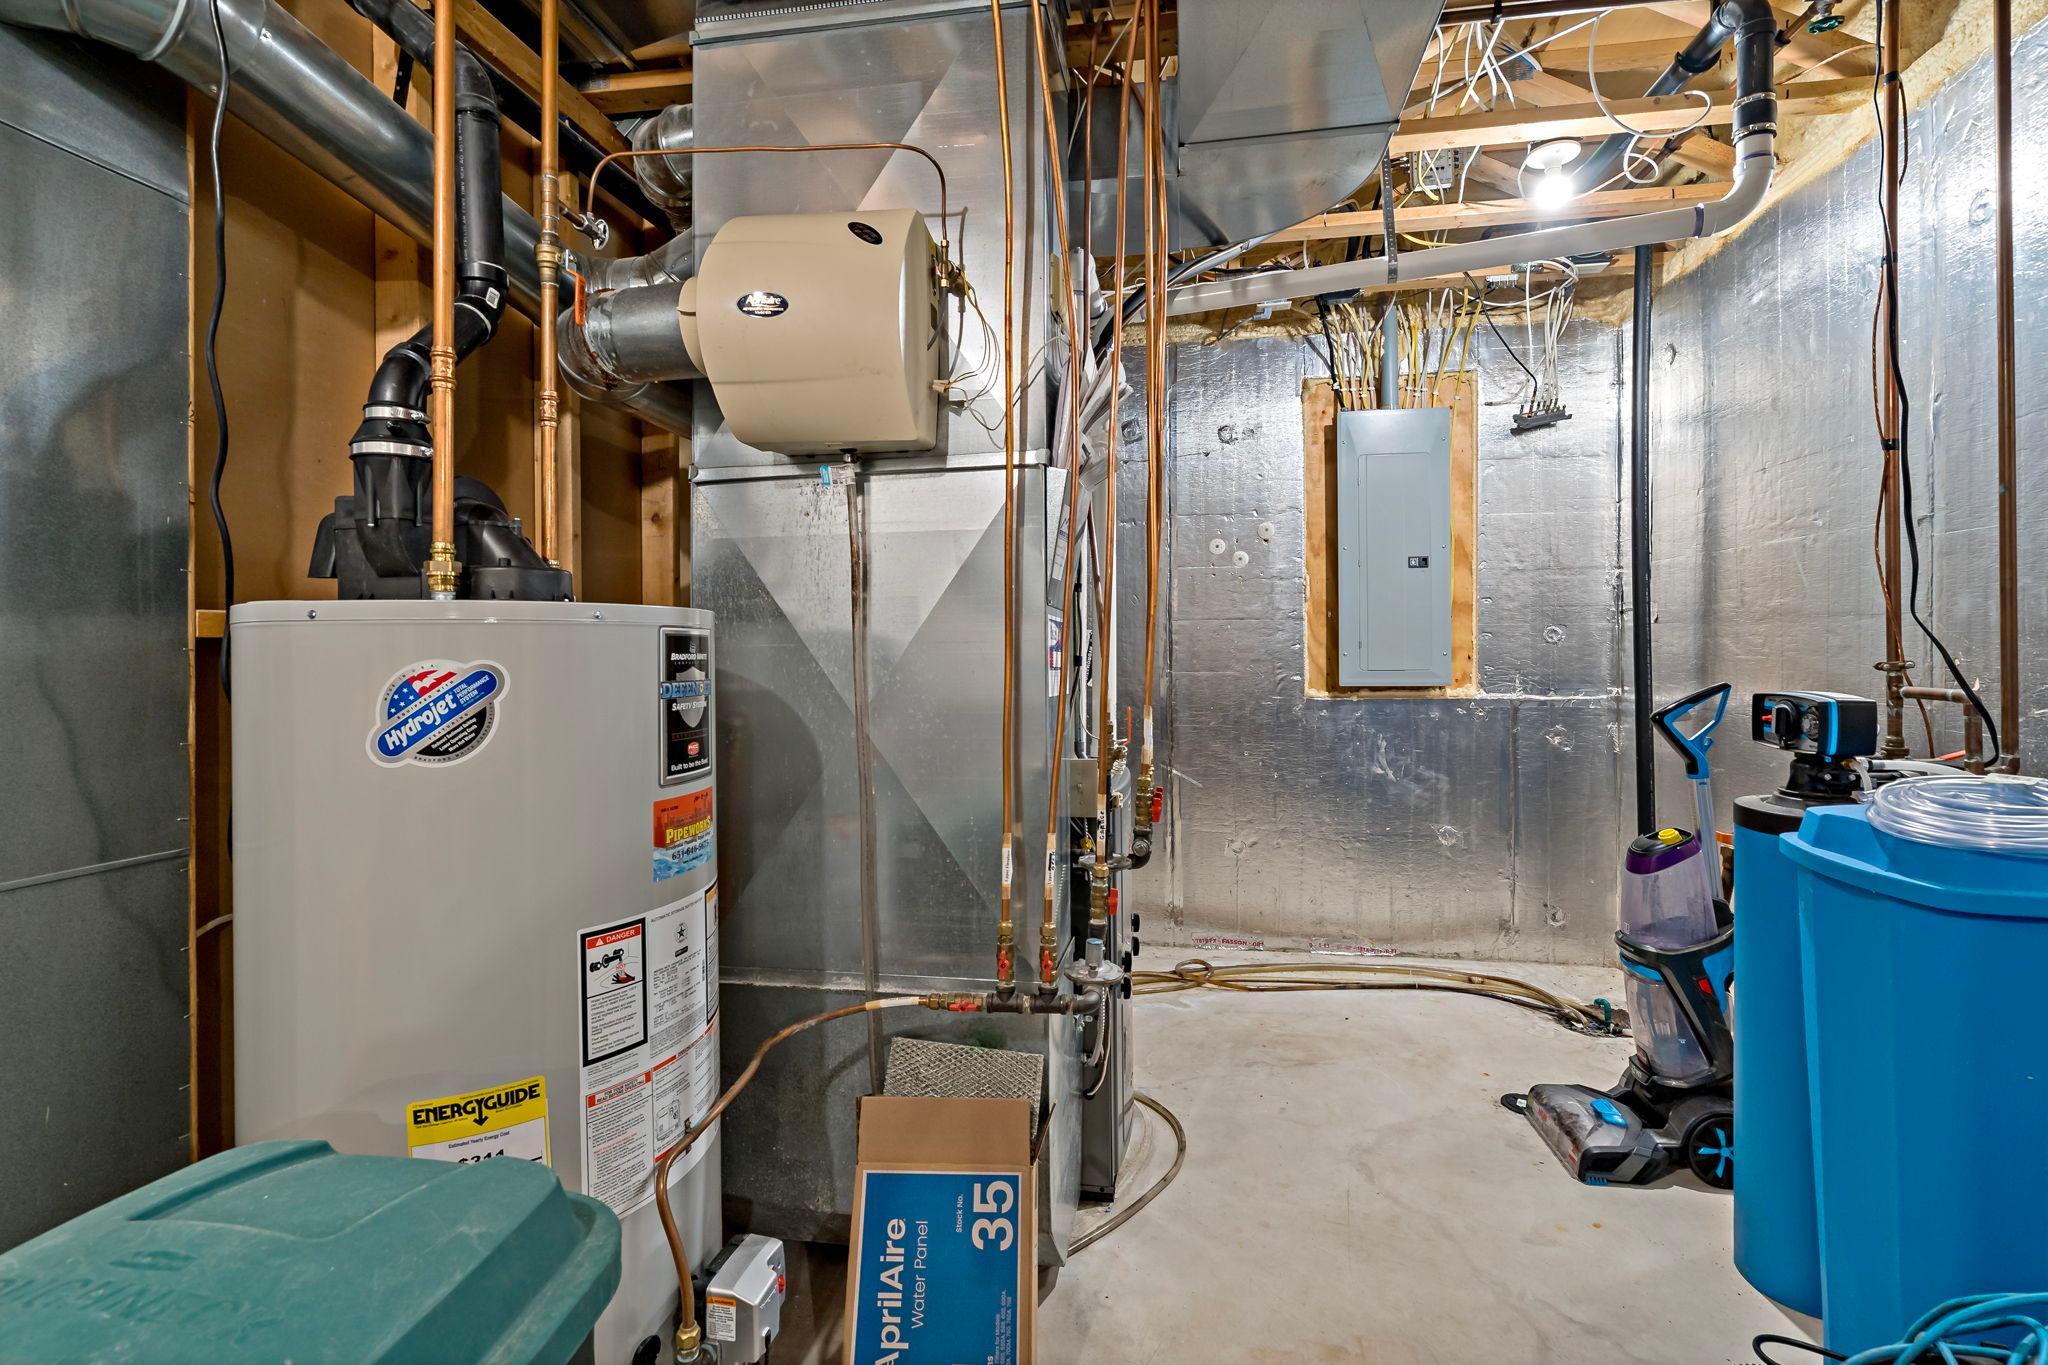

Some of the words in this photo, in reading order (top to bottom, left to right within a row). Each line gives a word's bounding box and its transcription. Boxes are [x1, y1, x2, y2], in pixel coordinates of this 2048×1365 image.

[456, 675, 490, 698] PERFORMANCE
[459, 690, 479, 704] SYSTEM
[672, 702, 692, 711] SAFETY
[384, 693, 457, 750] Hydrojet
[665, 815, 712, 844] PIPEWORKS
[606, 929, 635, 943] DANGER
[413, 1083, 541, 1125] ENERGYGUIDE
[448, 1139, 470, 1149] Estimated
[470, 1137, 484, 1145] Yearly
[484, 1133, 499, 1142] Energy
[971, 1180, 1014, 1251] 35
[914, 1220, 929, 1269] Panel
[911, 1274, 926, 1329] Water
